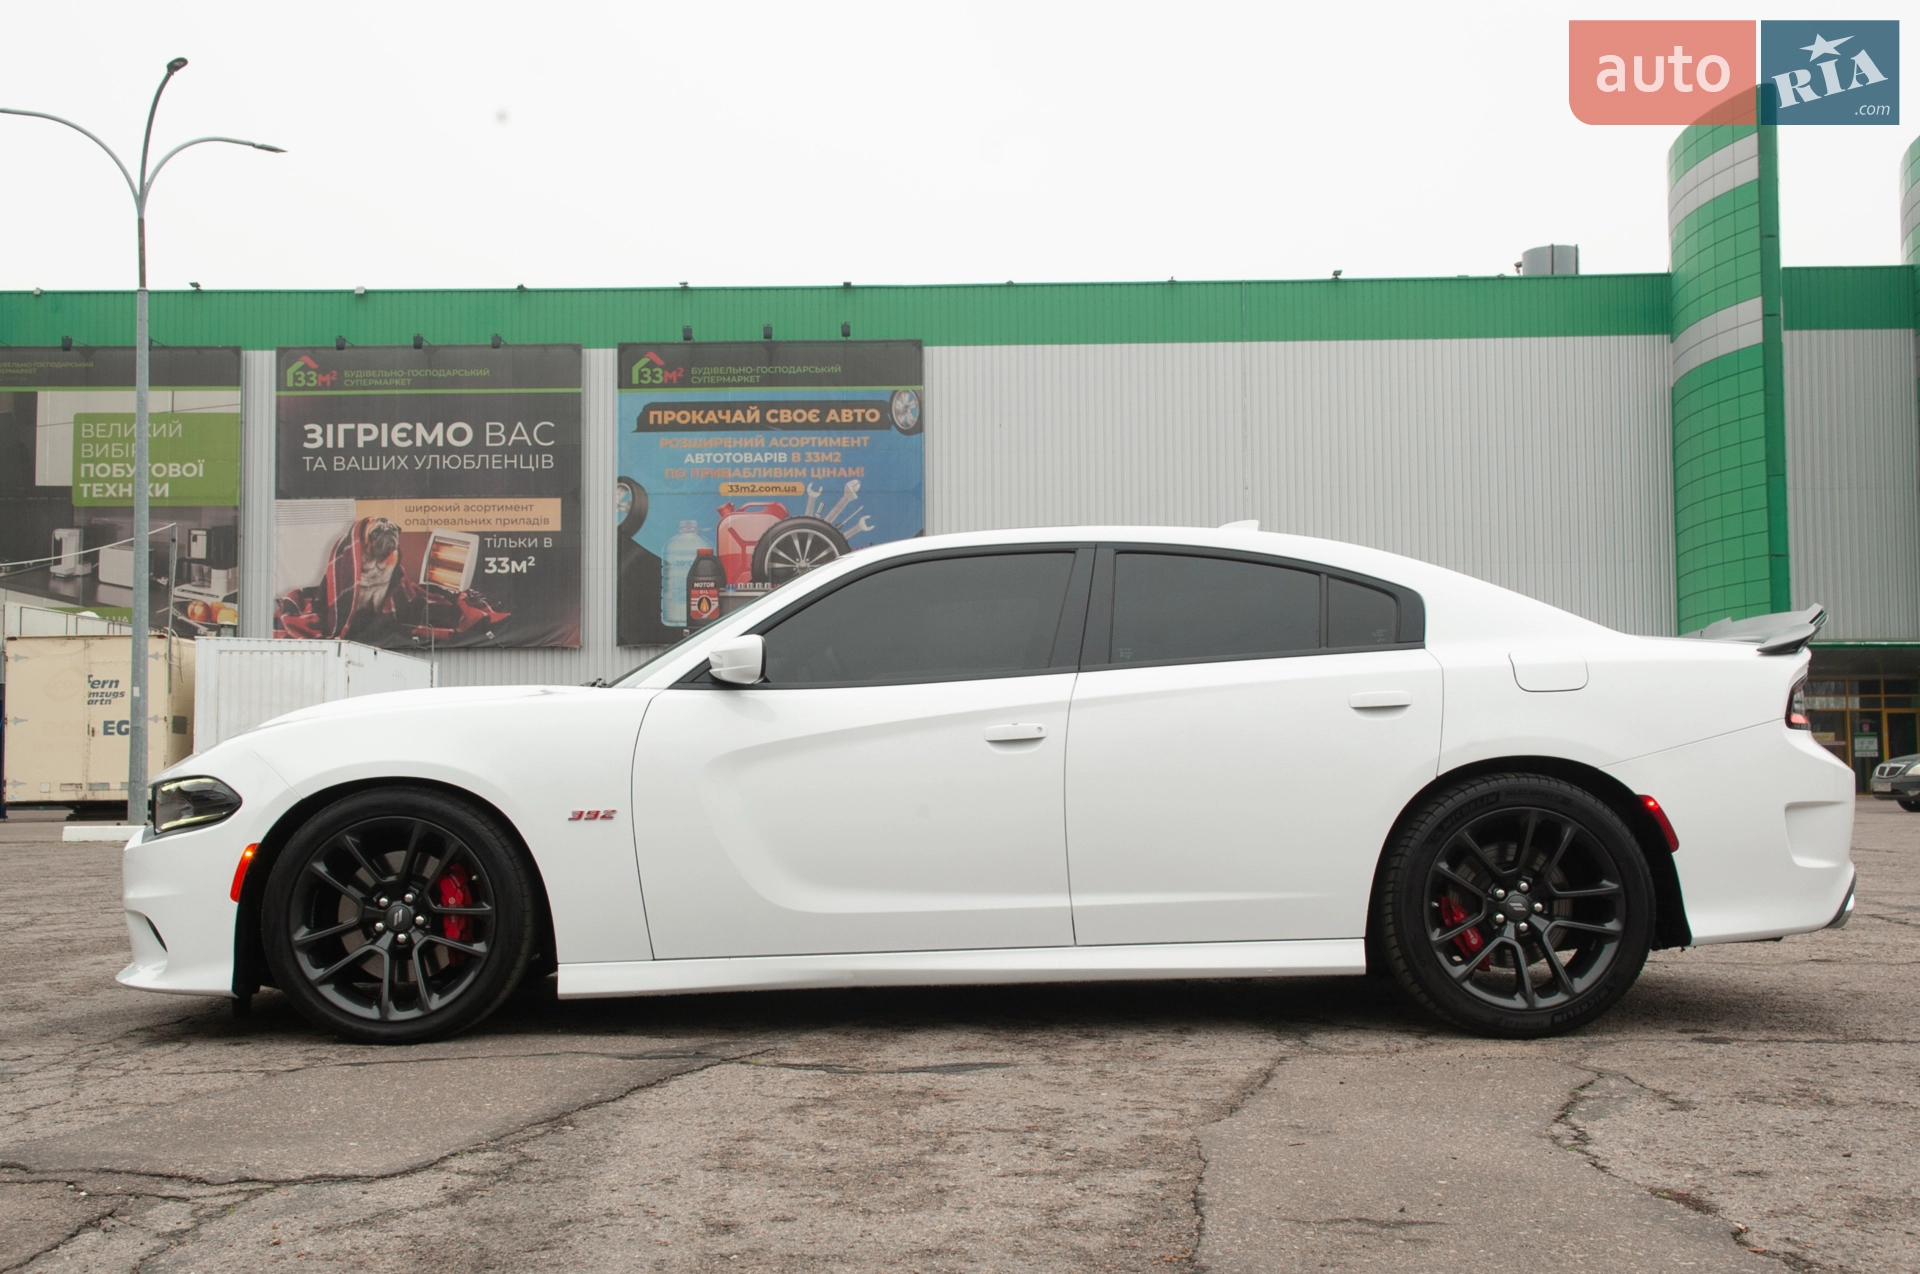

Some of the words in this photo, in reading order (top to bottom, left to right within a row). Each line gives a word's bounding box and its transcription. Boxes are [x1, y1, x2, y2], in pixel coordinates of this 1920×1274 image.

[344, 367, 490, 379] БУДІВЕЛЬНО-ГОСПОДАРСЬКИЙ
[691, 375, 761, 384] СУПЕРМАРКЕТ
[344, 378, 411, 387] СУПЕРМАРКЕТ
[649, 406, 761, 424] ПРОКАЧАЙ
[766, 408, 820, 423] СВОЄ
[825, 407, 881, 423] АВТО
[81, 419, 182, 438] ВЕЛИИЙ
[302, 422, 473, 449] ЗІГРІЄМО
[485, 421, 555, 447] ВАС
[660, 435, 765, 449] РОЗШИРЕНИЙ
[769, 436, 870, 448] АСОРТИМЕНТ
[302, 456, 327, 471] ТА
[333, 455, 408, 471] ВАШИХ
[414, 454, 554, 472] УЛЮБЛЕНЦІВ
[684, 452, 788, 464] АВТОТОВАРІВ
[791, 452, 801, 463] В
[804, 451, 842, 463] 33М2
[80, 459, 205, 478] ПОБУОВОЇ
[665, 468, 687, 480] ПО
[691, 467, 806, 479] ПРИВАБЛИВИМ
[810, 466, 865, 480] ЦІНАМ!
[79, 483, 169, 497] ТЕХНИ
[728, 483, 797, 493] 33m2.com.ua
[405, 502, 460, 514] широкий
[463, 503, 534, 513] асортимент
[404, 517, 492, 526] опалювальних
[495, 516, 550, 528] приладів
[484, 534, 538, 548] тільки
[568, 809, 617, 821] 392
